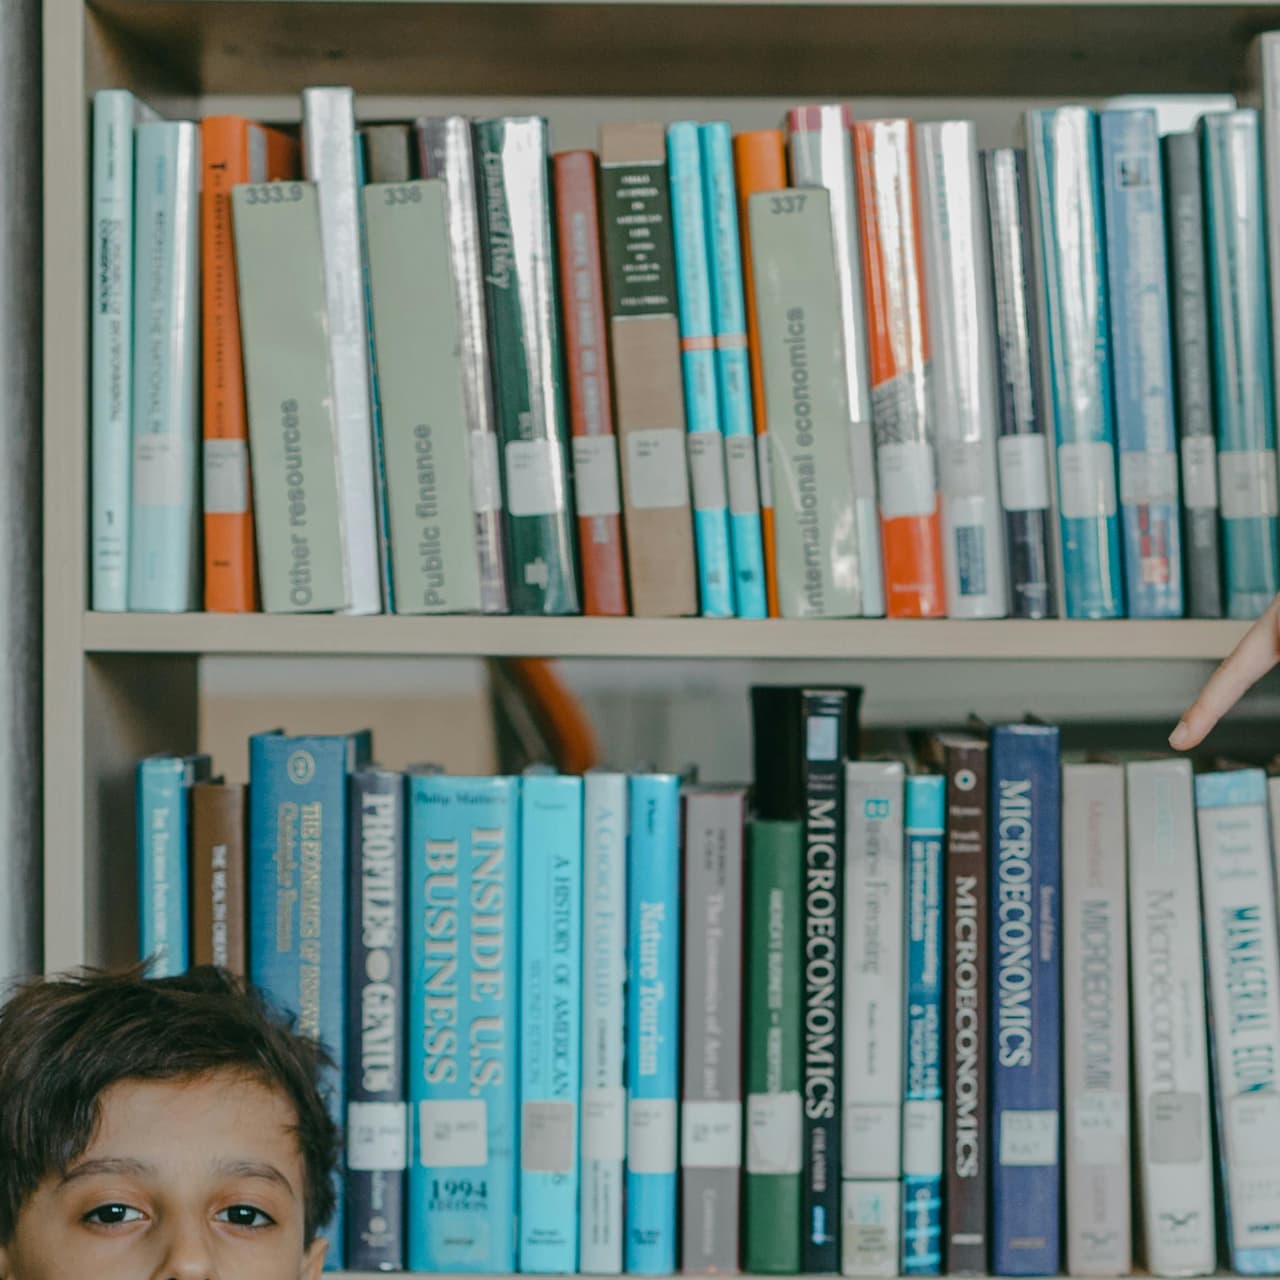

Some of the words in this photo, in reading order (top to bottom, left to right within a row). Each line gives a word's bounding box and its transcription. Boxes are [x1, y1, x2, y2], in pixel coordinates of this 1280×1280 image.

[244, 183, 304, 206] 333.9
[769, 195, 808, 214] 337
[782, 306, 814, 447] economics
[277, 398, 308, 527] resources
[411, 423, 439, 518] finance
[288, 533, 313, 607] Other
[419, 526, 447, 607] Public
[300, 802, 322, 838] THE
[864, 798, 890, 878] Business
[300, 840, 322, 938] ECONOMICS
[361, 792, 397, 949] PROFILES
[552, 855, 572, 869] A
[470, 827, 506, 1002] INSIDE
[552, 876, 573, 954] HISTORY
[639, 901, 665, 979] Nature
[706, 894, 725, 927] The
[857, 879, 892, 977] Forecasting
[999, 779, 1033, 1068] MICROECONOMICS
[1040, 922, 1055, 963] Edition
[300, 940, 322, 964] OF
[423, 838, 460, 1085] BUSINESS
[528, 959, 545, 1018] SECOND
[552, 963, 573, 987] OF
[806, 799, 837, 1120] MICROECONOMICS
[1144, 888, 1181, 1095] Microeconom
[1221, 904, 1270, 1036] MANAGERIAL
[639, 980, 665, 1077] Tourism
[954, 875, 980, 1179] MICROECONOMICS
[1079, 899, 1112, 1091] MICROECONOMI
[361, 983, 397, 1093] GENIUS
[469, 1015, 506, 1097] U.S.
[528, 1022, 544, 1085] EDITION
[551, 995, 572, 1098] AMERICAN
[704, 1036, 723, 1065] Art
[704, 1068, 722, 1098] and
[431, 1179, 488, 1201] 1994
